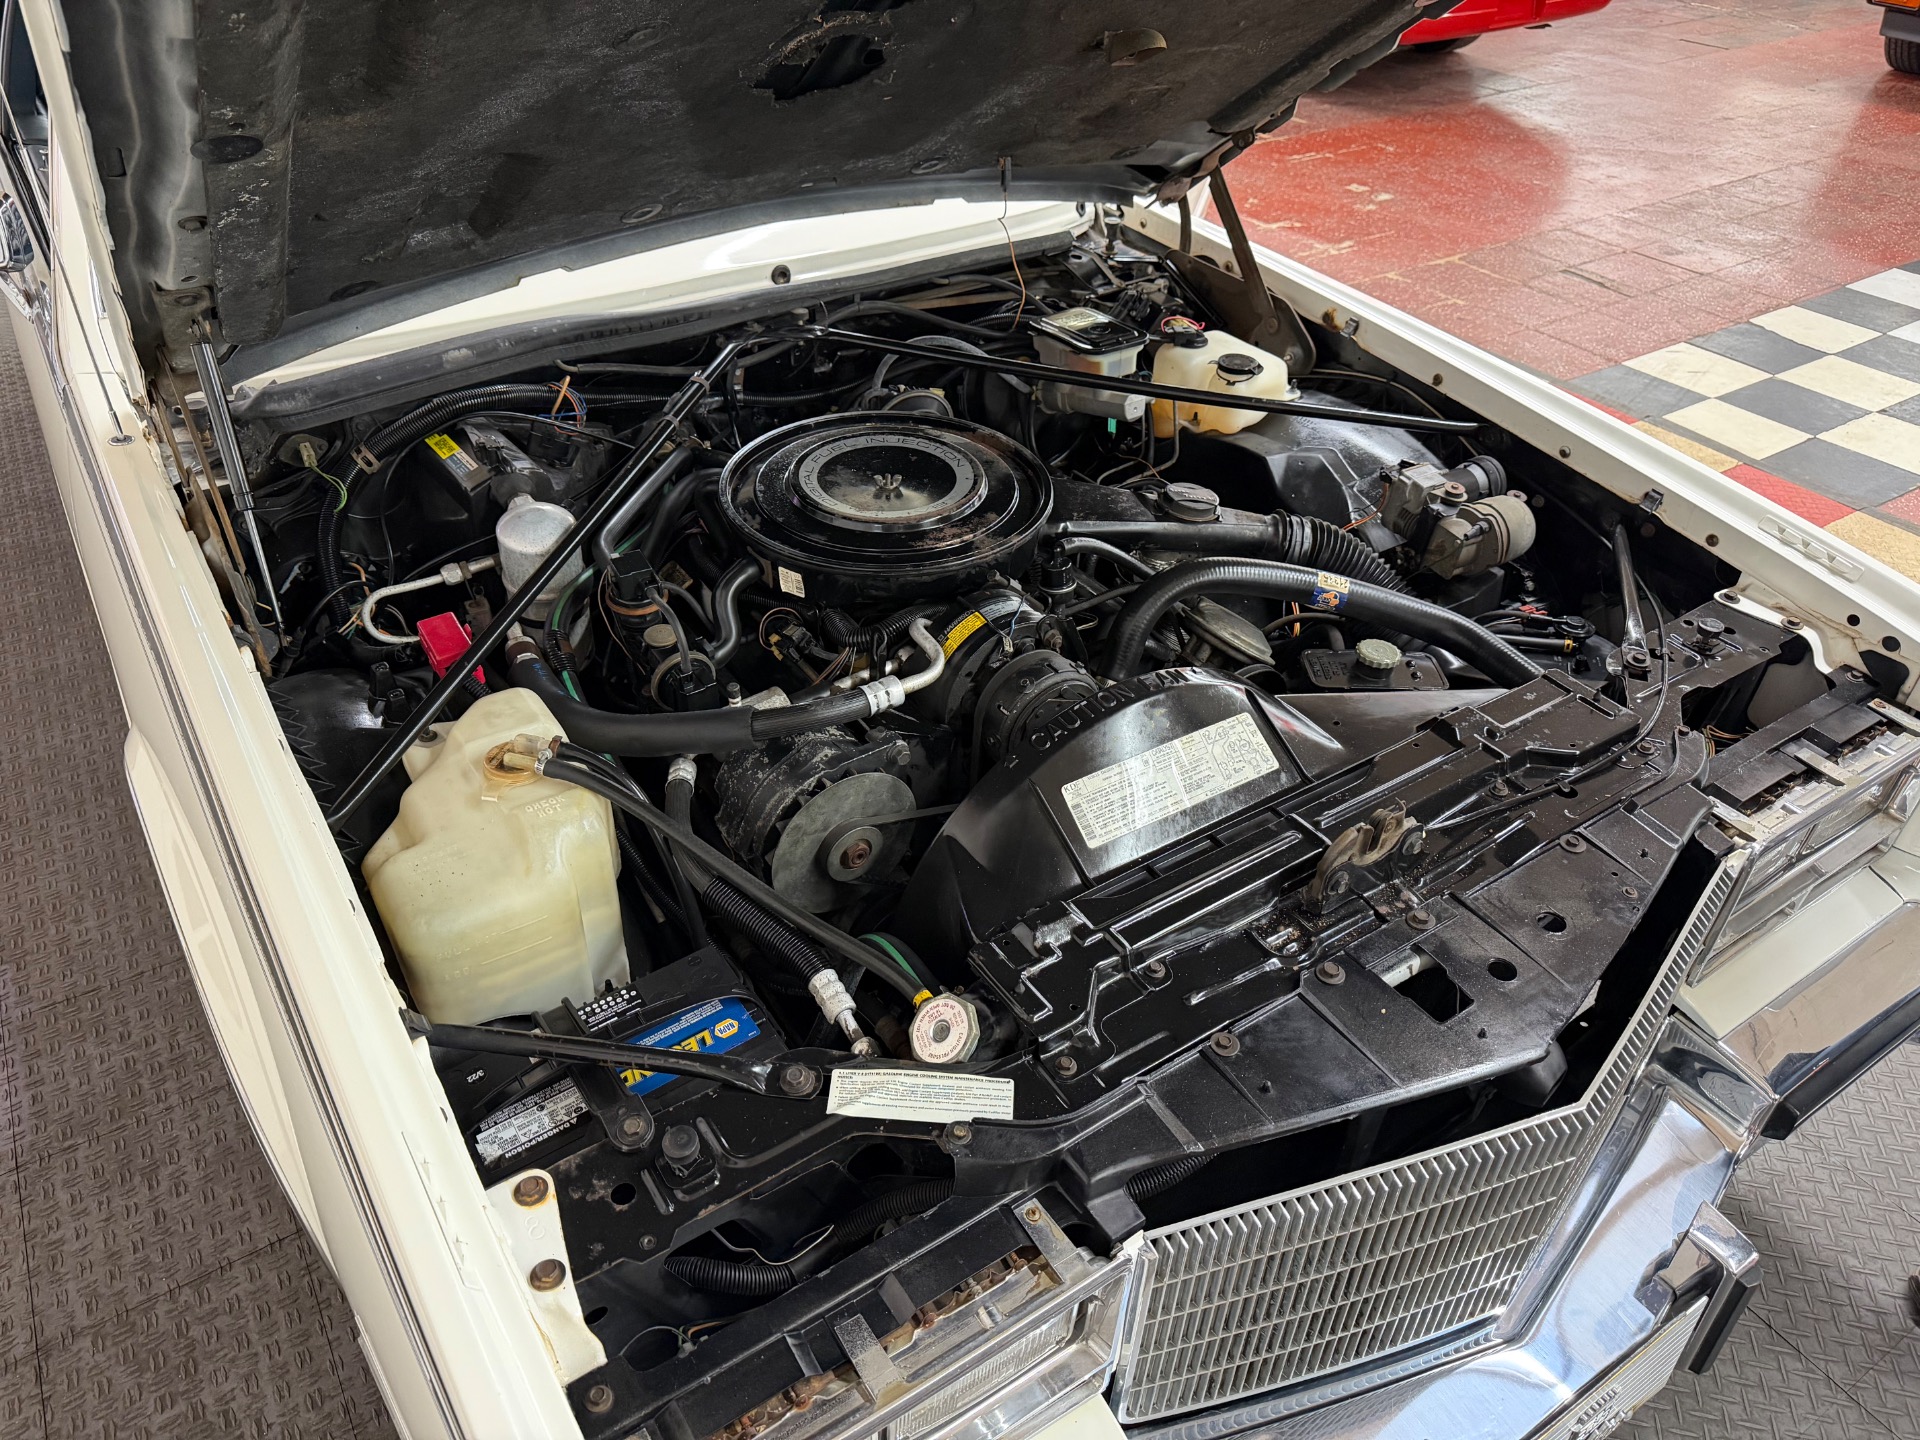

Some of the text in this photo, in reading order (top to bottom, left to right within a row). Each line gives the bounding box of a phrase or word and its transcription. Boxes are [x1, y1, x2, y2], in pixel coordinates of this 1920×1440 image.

[803, 437, 966, 507] DIGITAL FUEL INJECTION
[1029, 668, 1191, 751] CAUTION FAN
[524, 796, 566, 813] CHECK
[537, 803, 561, 818] HOT
[717, 1021, 736, 1035] NAPA
[466, 1069, 485, 1084] 3/22
[504, 1120, 571, 1159] DANGER/POISON
